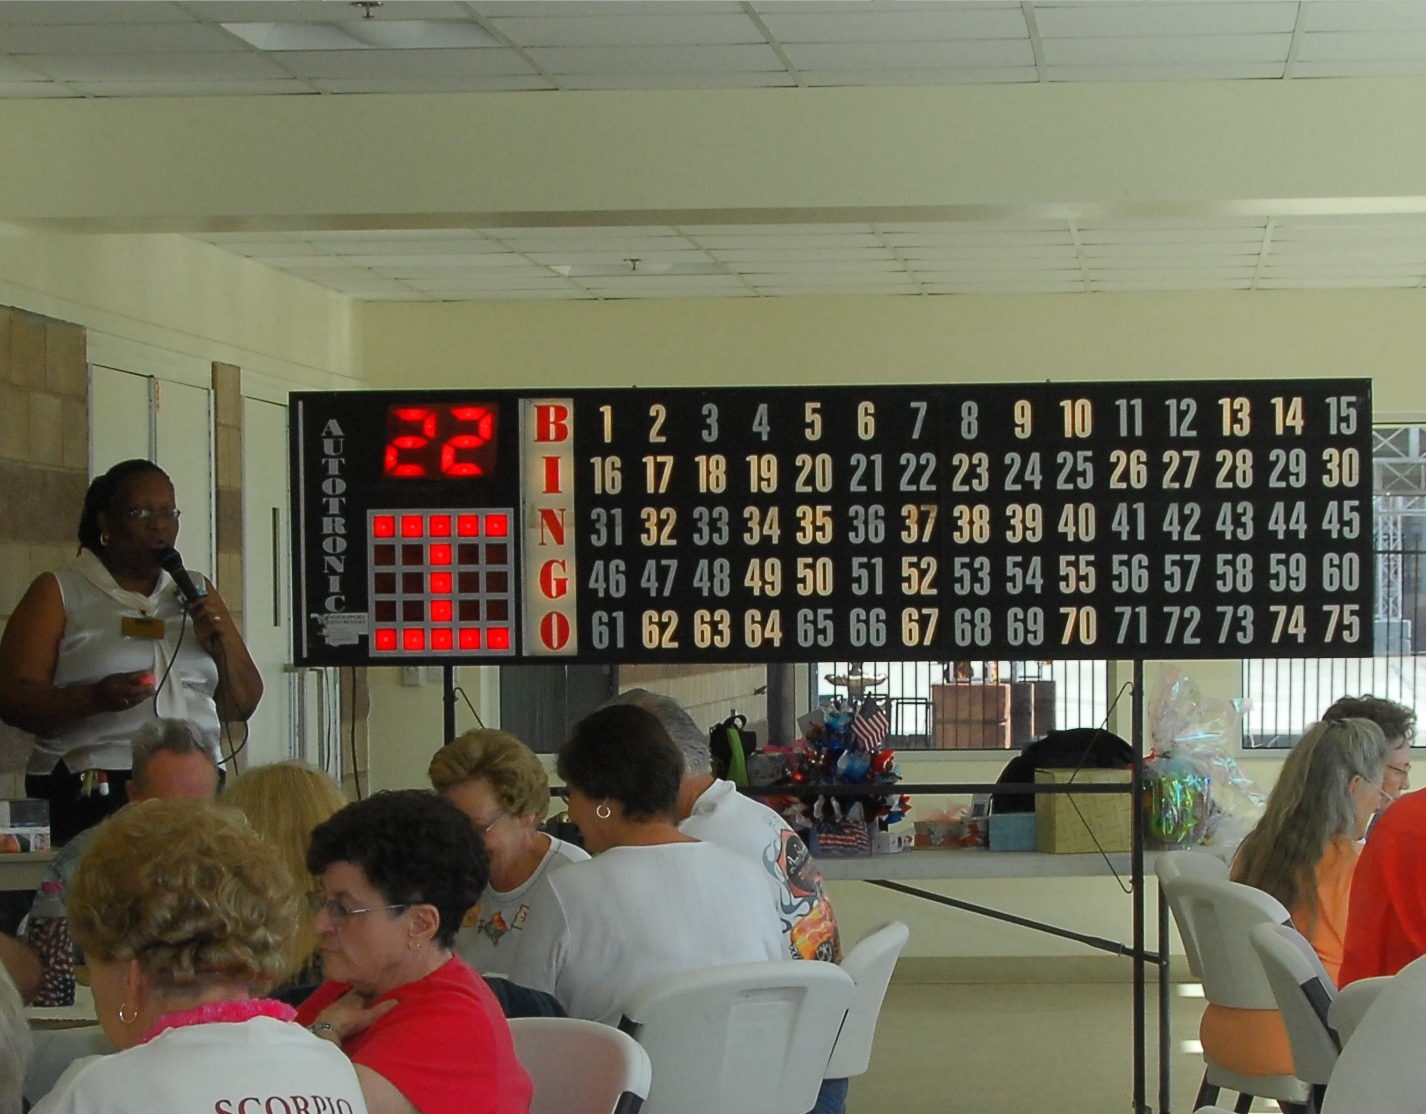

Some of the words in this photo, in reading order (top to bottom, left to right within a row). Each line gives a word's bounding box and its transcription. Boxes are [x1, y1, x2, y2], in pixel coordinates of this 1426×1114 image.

[383, 406, 494, 478] 22
[600, 405, 611, 443] 1
[650, 404, 666, 442] 2
[702, 404, 718, 442] 3
[753, 404, 770, 440] 4
[805, 402, 821, 440] 5
[858, 401, 875, 440] 6
[911, 402, 927, 439] 7
[961, 401, 978, 439] 8
[1014, 400, 1031, 439] 9
[1060, 399, 1092, 438] 10
[1115, 399, 1142, 436] 11
[1165, 398, 1197, 436] 12
[1218, 397, 1250, 437] 13
[1271, 397, 1304, 435] 14
[1325, 396, 1357, 435] 15
[590, 456, 621, 494] 16
[642, 456, 673, 493] 17
[695, 454, 726, 493] 18
[746, 454, 777, 493] 19
[796, 453, 832, 492] 20
[850, 454, 881, 491] 21
[900, 453, 936, 491] 22
[953, 452, 988, 491] 23
[1005, 452, 1042, 490] 24
[1057, 451, 1093, 489] 25
[1110, 449, 1147, 489] 26
[1163, 450, 1200, 489] 27
[1216, 449, 1253, 488] 28
[1269, 448, 1306, 488] 29
[1322, 448, 1359, 487] 30
[321, 419, 348, 612] AUTOTRONIC
[591, 508, 621, 546] 31
[641, 507, 676, 546] 32
[694, 507, 728, 545] 33
[744, 506, 780, 545] 34
[796, 505, 832, 544] 35
[849, 505, 884, 543] 36
[901, 504, 937, 543] 37
[953, 504, 990, 544] 38
[1006, 504, 1042, 543] 39
[1058, 503, 1095, 542] 40
[1112, 503, 1144, 540] 41
[1163, 503, 1200, 541] 42
[1216, 501, 1253, 540] 43
[1268, 501, 1307, 539] 44
[1322, 500, 1360, 539] 45
[589, 560, 625, 597] 46
[641, 560, 677, 596] 47
[694, 559, 730, 596] 48
[744, 558, 781, 596] 49
[797, 557, 833, 596] 50
[852, 557, 882, 595] 51
[902, 557, 937, 595] 52
[955, 557, 990, 595] 53
[1007, 556, 1043, 594] 54
[1060, 555, 1095, 594] 55
[1112, 554, 1148, 593] 56
[1165, 555, 1200, 593] 57
[1217, 554, 1253, 592] 58
[1270, 553, 1306, 592] 59
[1323, 552, 1359, 591] 60
[593, 611, 623, 648] 61
[642, 610, 678, 648] 62
[694, 609, 730, 648] 63
[745, 609, 782, 648] 64
[798, 609, 833, 647] 65
[850, 608, 886, 646] 66
[902, 607, 938, 646] 67
[955, 608, 991, 646] 68
[1008, 607, 1043, 645] 69
[1060, 606, 1096, 645] 70
[1115, 606, 1146, 643] 71
[1164, 606, 1200, 644] 72
[1217, 605, 1253, 644] 73
[1270, 605, 1306, 643] 74
[1323, 604, 1359, 643] 75
